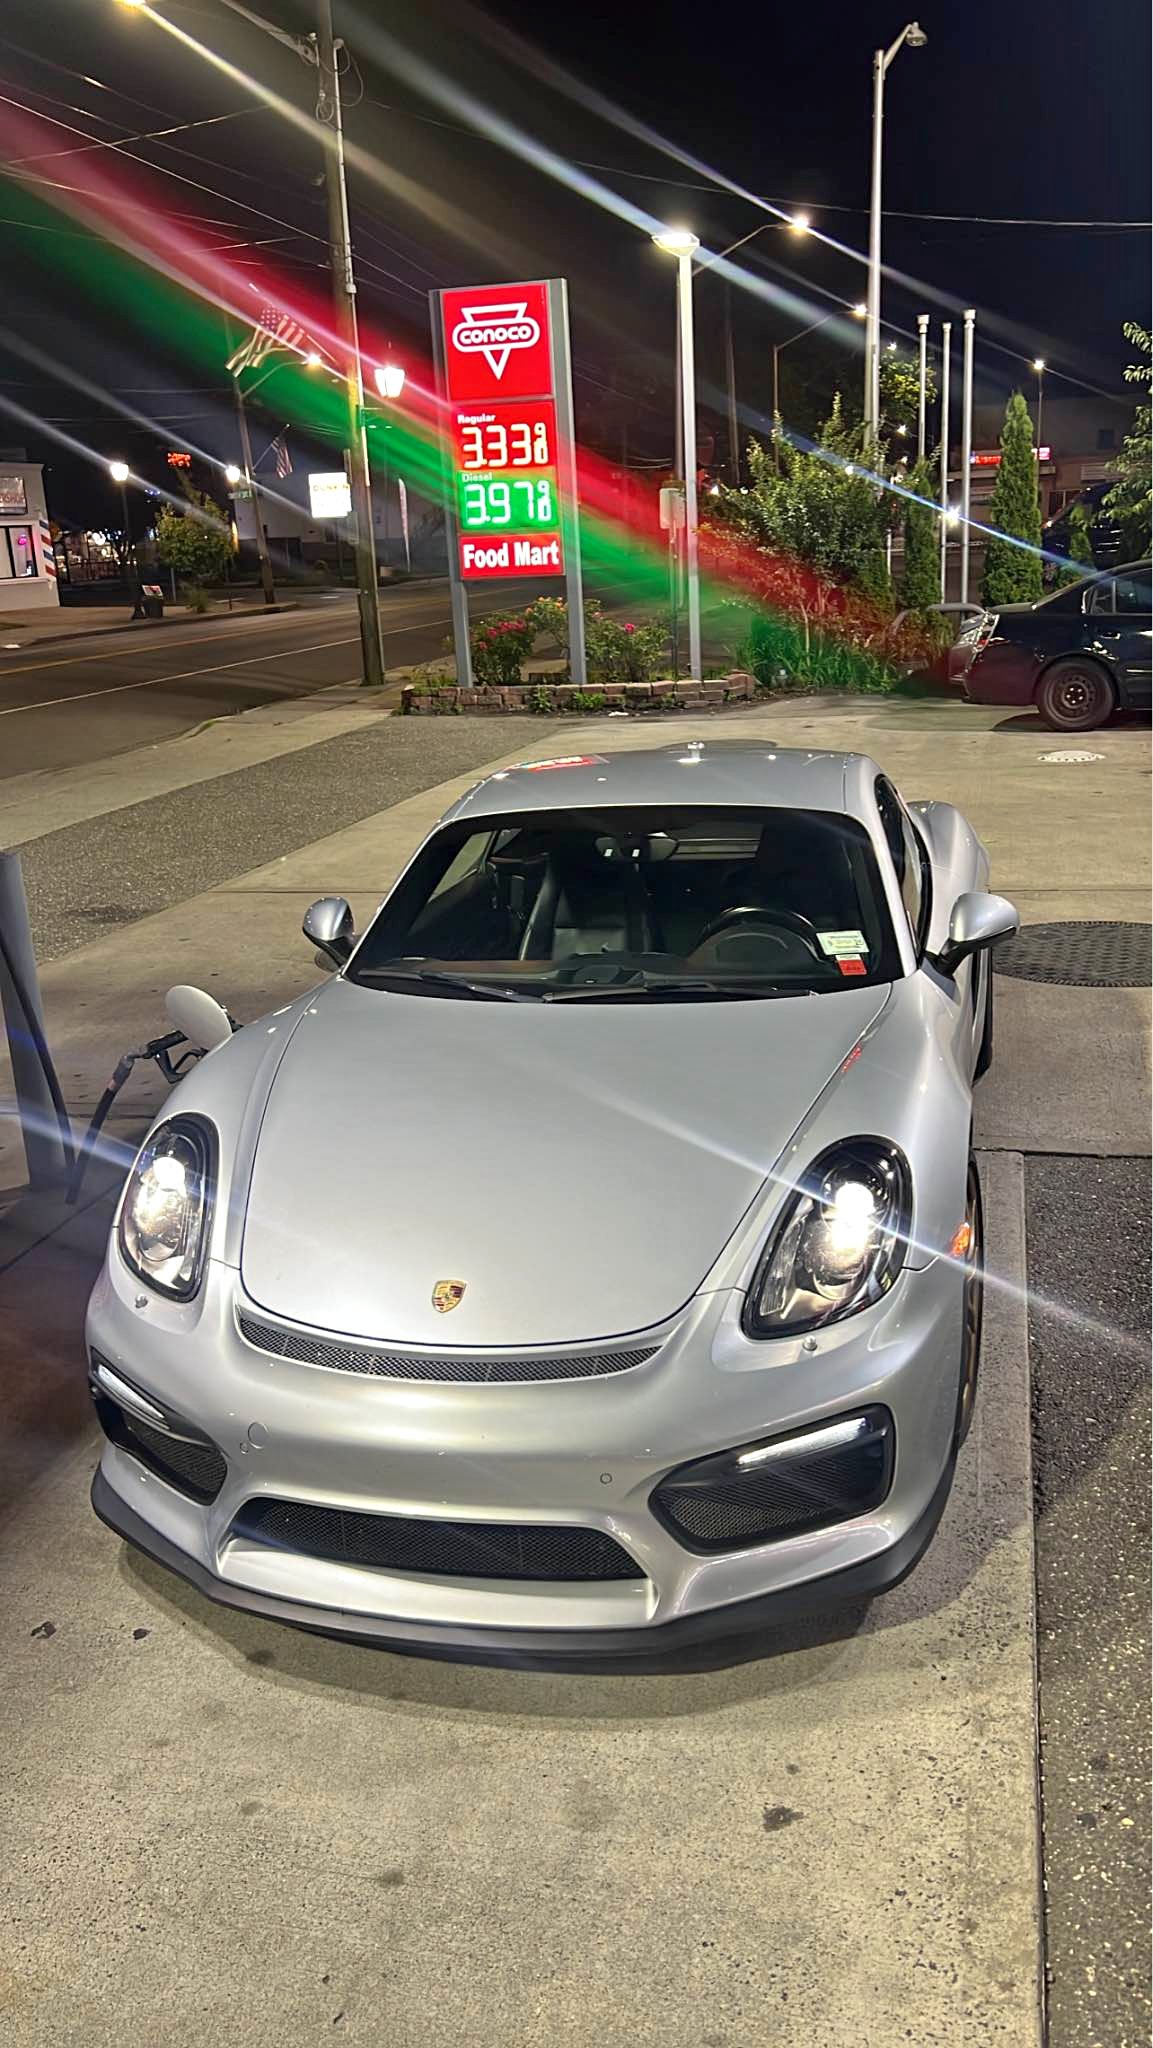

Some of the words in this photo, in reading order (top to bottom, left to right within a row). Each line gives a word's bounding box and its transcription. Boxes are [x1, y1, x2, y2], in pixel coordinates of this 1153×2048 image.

[457, 413, 496, 425] Regular
[462, 472, 492, 482] Diesel
[463, 542, 510, 569] Food
[514, 541, 560, 567] Mart
